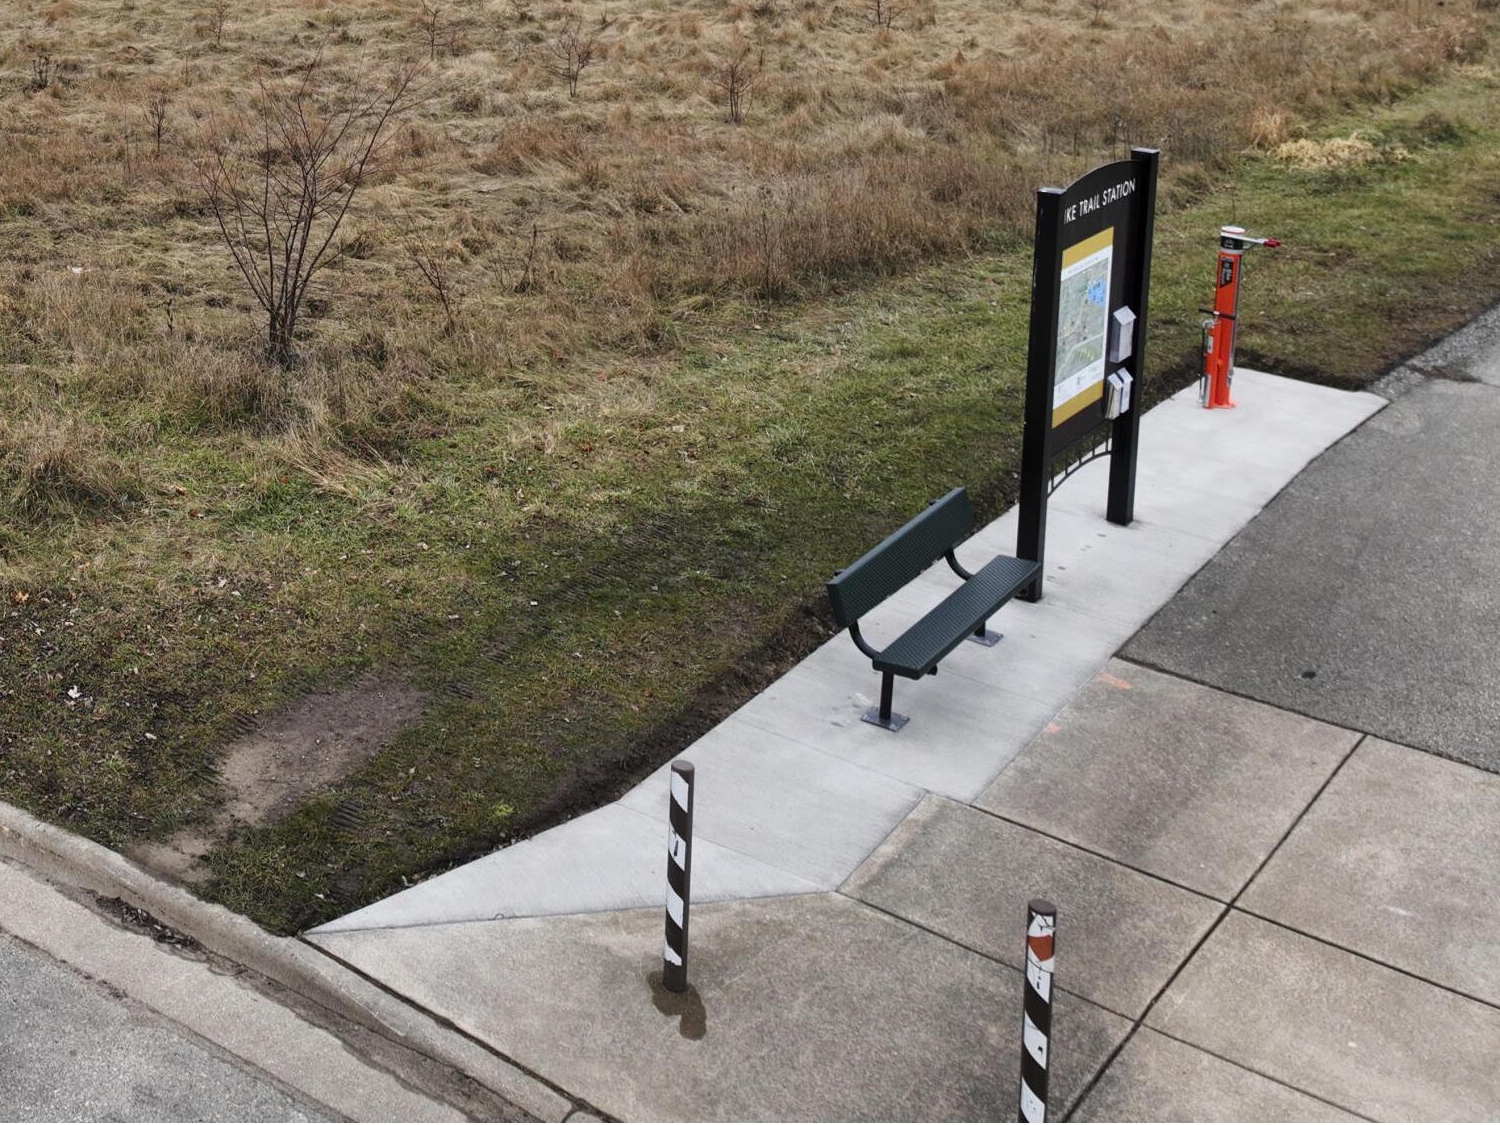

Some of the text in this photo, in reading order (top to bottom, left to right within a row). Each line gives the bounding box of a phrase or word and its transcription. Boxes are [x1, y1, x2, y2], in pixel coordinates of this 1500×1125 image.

[1063, 177, 1136, 225] IKE TRAIL STATION
